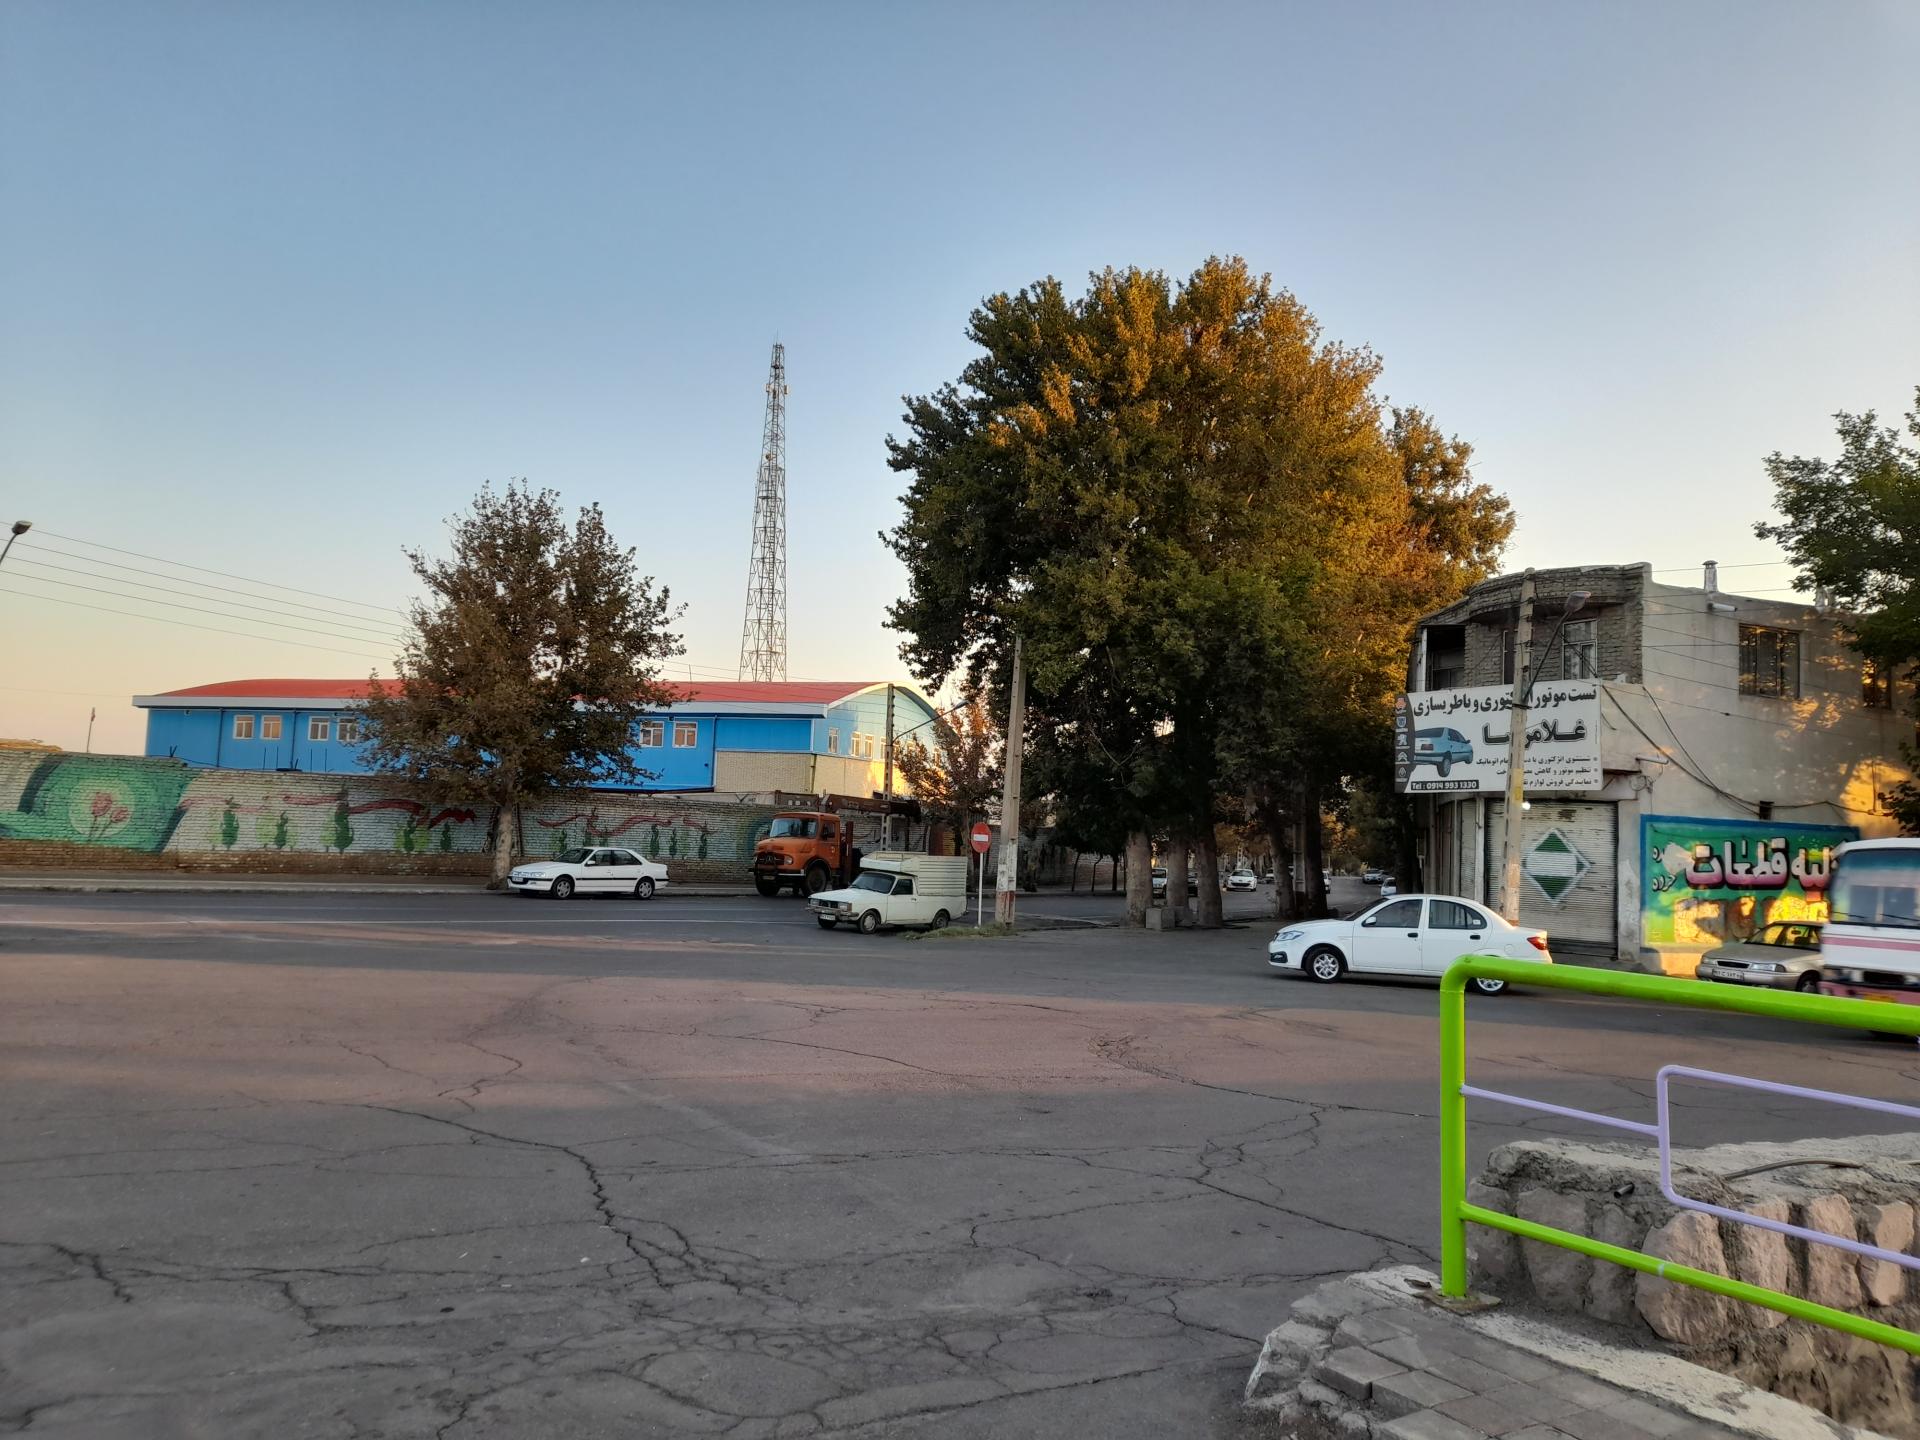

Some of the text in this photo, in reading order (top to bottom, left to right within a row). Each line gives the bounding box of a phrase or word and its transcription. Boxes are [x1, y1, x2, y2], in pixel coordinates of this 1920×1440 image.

[1534, 687, 1567, 709] موتور
[1568, 684, 1597, 702] تست
[1472, 699, 1479, 713] و
[1482, 718, 1587, 750] غلامرا
[1426, 782, 1443, 790] 0914
[1459, 781, 1477, 789] 1330
